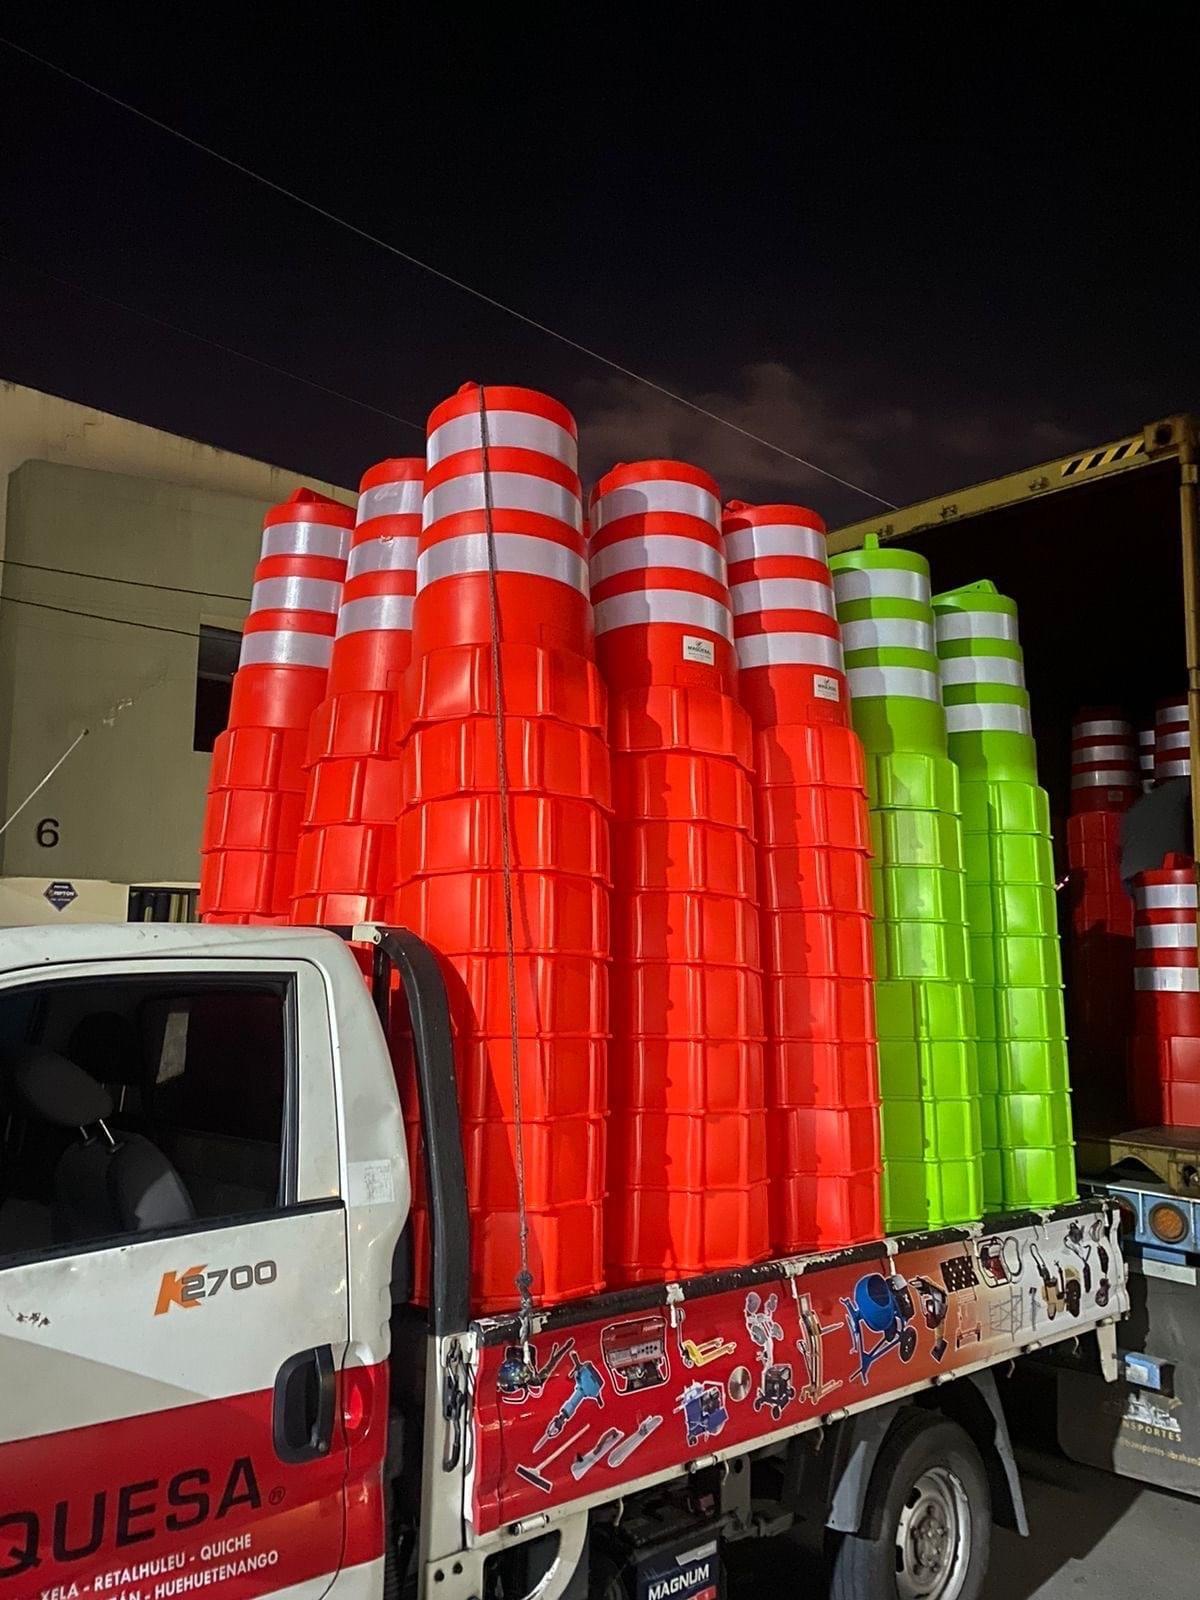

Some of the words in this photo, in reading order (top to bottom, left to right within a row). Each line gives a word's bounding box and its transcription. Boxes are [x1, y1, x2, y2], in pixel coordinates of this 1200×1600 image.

[36, 818, 60, 848] 6
[94, 1551, 186, 1592] RETALHULEU
[200, 1533, 252, 1561] QUICHE
[155, 1550, 279, 1600] HUEHUETENANGO
[648, 1563, 710, 1600] MAGNUM
